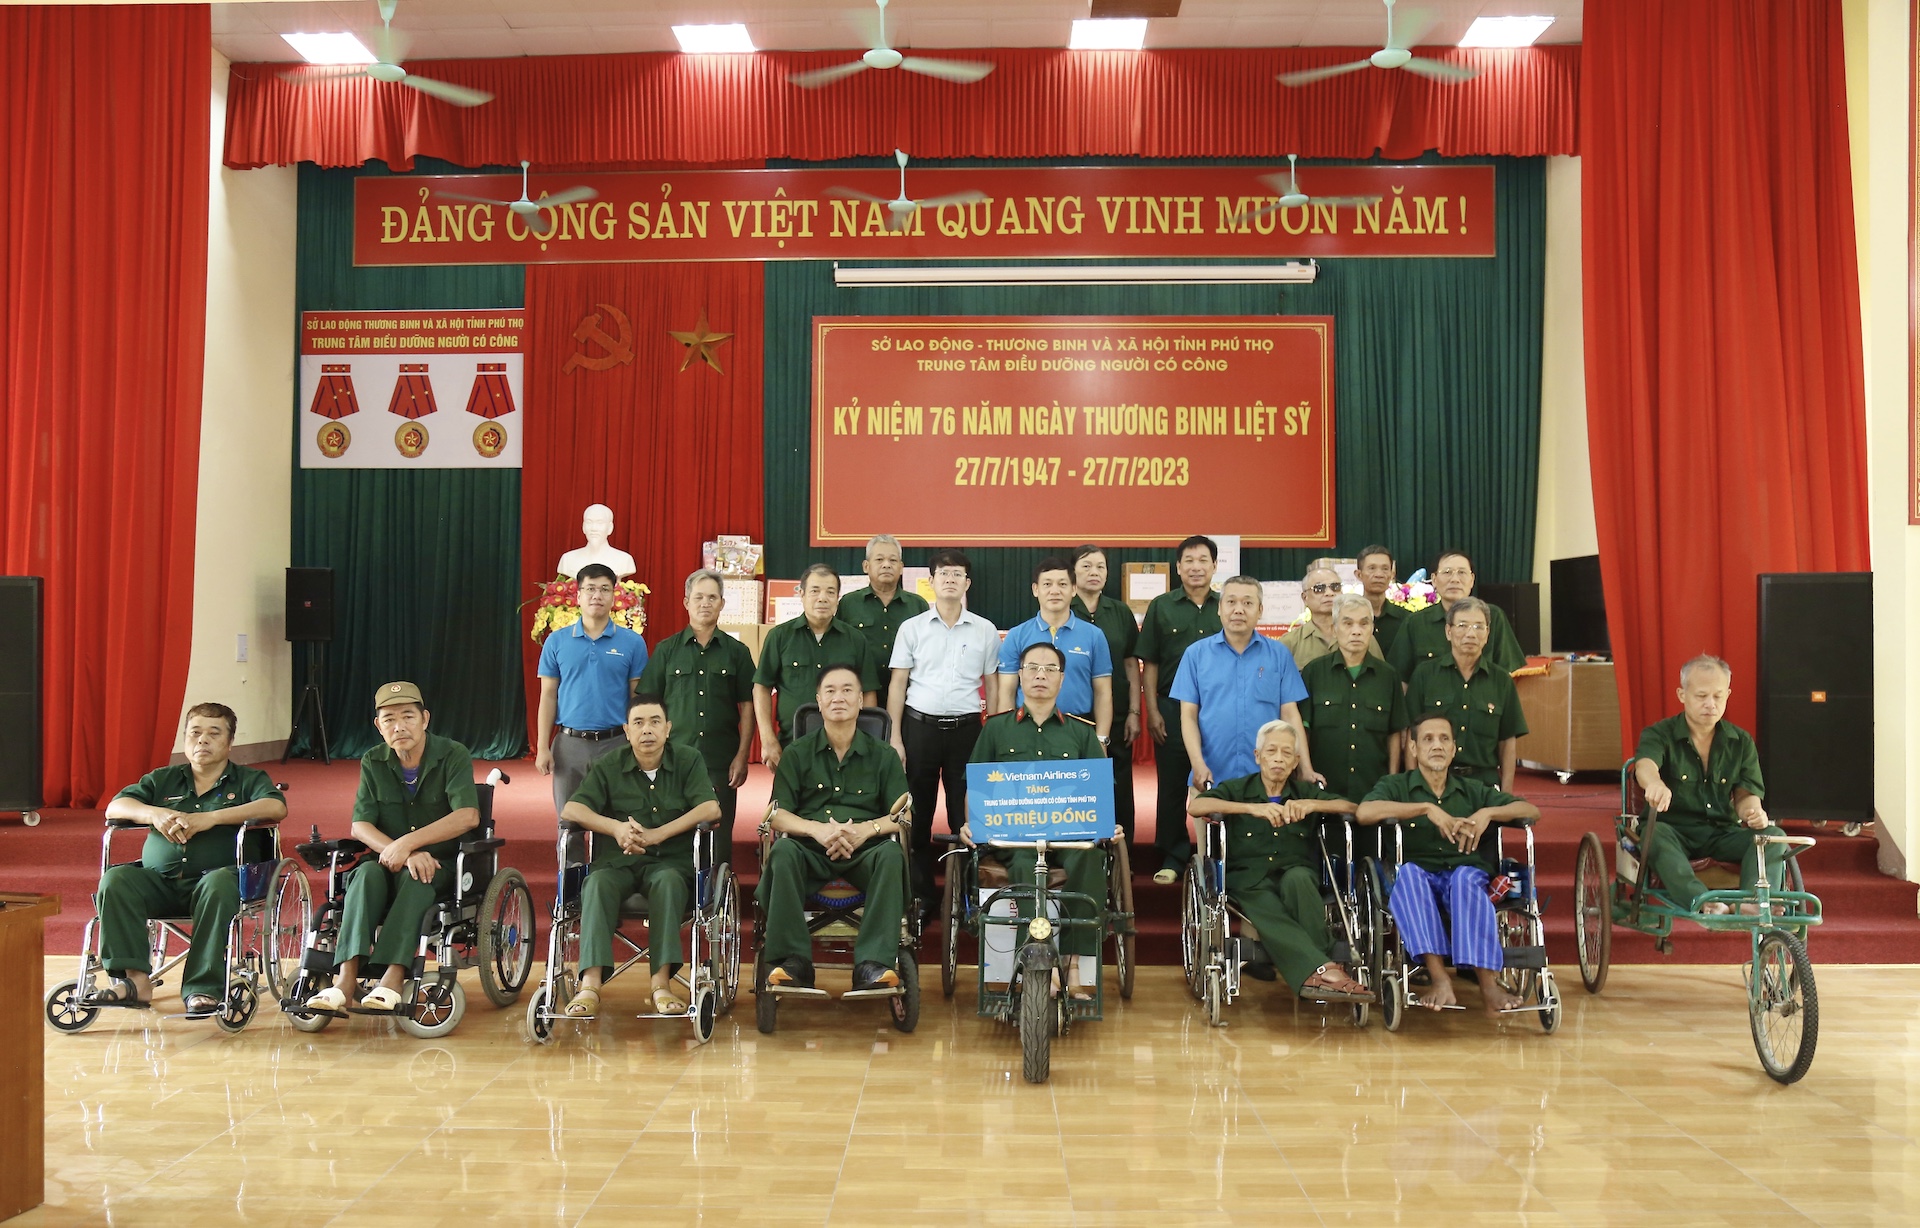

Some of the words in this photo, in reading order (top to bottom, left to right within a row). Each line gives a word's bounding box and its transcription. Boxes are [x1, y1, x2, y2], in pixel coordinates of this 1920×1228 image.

[381, 187, 495, 243] ĐẢNG
[506, 190, 618, 252] CỘNG
[628, 183, 711, 240] SẢN
[722, 187, 818, 249] VIỆT
[829, 199, 926, 237] NAM
[936, 195, 1085, 239] QUANG
[1097, 196, 1205, 234] VINH
[1353, 185, 1449, 235] NĂM
[1459, 195, 1468, 235] !
[307, 317, 319, 330] SỞ
[320, 320, 337, 330] LAO
[338, 318, 362, 332] ĐỘNG
[364, 319, 398, 330] THƯƠNG
[400, 319, 421, 330] BINH
[422, 317, 434, 330] VÀ
[436, 317, 448, 329] XÃ
[450, 317, 465, 331] HỘI
[467, 315, 487, 329] TỈNH
[488, 317, 506, 329] PHÚ
[508, 318, 525, 330] THỌ
[312, 337, 346, 349] TRUNG
[348, 335, 371, 349] TÂM
[373, 333, 397, 349] ĐIỀU
[400, 334, 435, 349] DƯỠNG
[438, 334, 470, 348] NGƯỜI
[473, 334, 486, 348] CÓ
[489, 334, 519, 348] CÔNG
[871, 335, 892, 351] SỞ
[896, 339, 925, 351] LAO
[928, 336, 975, 354] ĐỘNG
[986, 338, 1048, 351] THƯƠNG
[1052, 340, 1087, 351] BINH
[1092, 337, 1112, 351] VÀ
[1117, 337, 1137, 351] XÃ
[1142, 336, 1170, 354] HỘI
[1173, 335, 1207, 351] TỈNH
[1211, 336, 1240, 351] PHÚ
[1244, 339, 1275, 355] THỌ
[917, 359, 966, 371] TRUNG
[970, 356, 1001, 371] TÂM
[1004, 354, 1038, 371] ĐIỀU
[1041, 357, 1096, 371] DƯỠNG
[1100, 356, 1150, 371] NGƯỜI
[1153, 357, 1178, 371] CÓ
[1182, 357, 1229, 371] CÔNG
[833, 396, 862, 436] KỶ
[867, 400, 923, 442] NIỆM
[929, 406, 956, 436] 76
[962, 400, 1013, 436] NĂM
[1019, 400, 1078, 436] NGÀY
[1083, 403, 1169, 436] THƯƠNG
[1175, 406, 1228, 436] BINH
[1233, 400, 1278, 442] LIỆT
[1284, 401, 1312, 436] SỸ
[954, 456, 1062, 487] 27/7/1947
[1082, 456, 1190, 487] 27/7/2023
[1004, 772, 1043, 781] Vietnam
[1042, 770, 1077, 780] Airlines
[1025, 785, 1050, 795] TẶNG
[984, 814, 1003, 827] 30
[1004, 810, 1048, 828] TRIỆU
[1051, 807, 1097, 824] ĐỒNG
